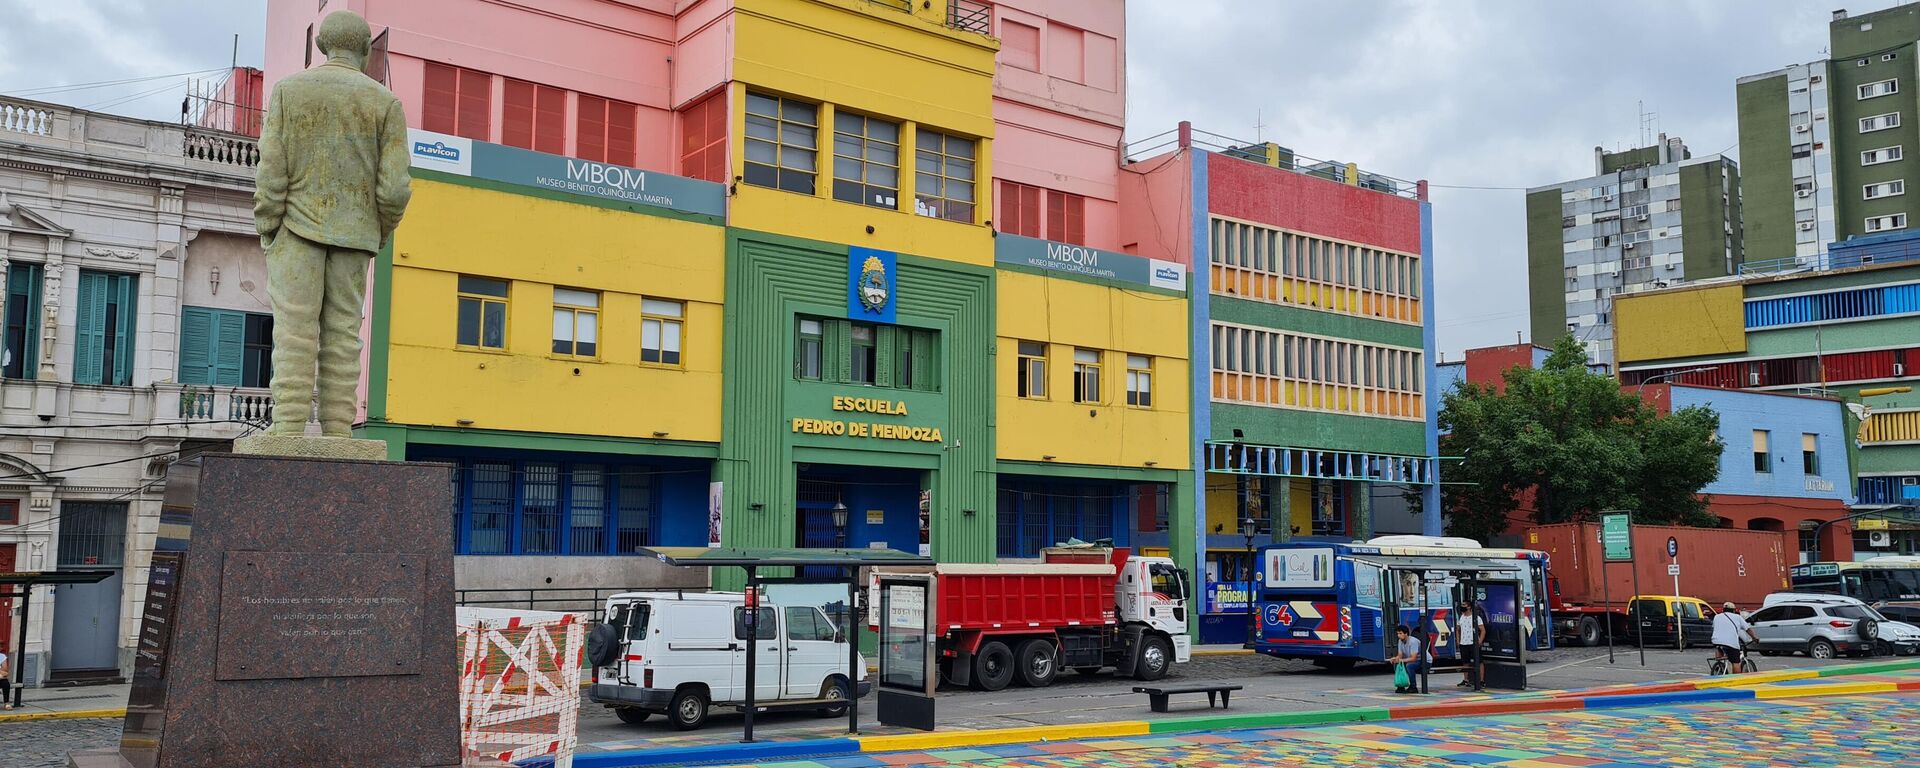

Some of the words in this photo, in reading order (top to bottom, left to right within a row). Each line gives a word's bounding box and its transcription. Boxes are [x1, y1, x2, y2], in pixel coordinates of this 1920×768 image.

[567, 159, 645, 191] MBQM
[536, 176, 566, 188] MUSEO
[567, 181, 596, 193] BENITO
[597, 186, 643, 200] QUINQUELA
[643, 195, 673, 205] MARTÍN
[1047, 243, 1098, 266] MBQM
[1028, 258, 1047, 267] MUSEO
[1048, 261, 1066, 270] BENITO
[1066, 263, 1096, 275] QUINQUELA
[1096, 268, 1116, 278] MARTÍN
[832, 395, 908, 415] ESCUELA
[792, 417, 845, 435] PEDRO
[848, 421, 868, 437] DE
[871, 424, 943, 442] MENDOZA
[1209, 444, 1292, 475] TEATRO
[1301, 451, 1324, 478] DE
[1333, 452, 1354, 479] LA
[1361, 453, 1433, 484] RIBERA
[1264, 603, 1293, 626] 64
